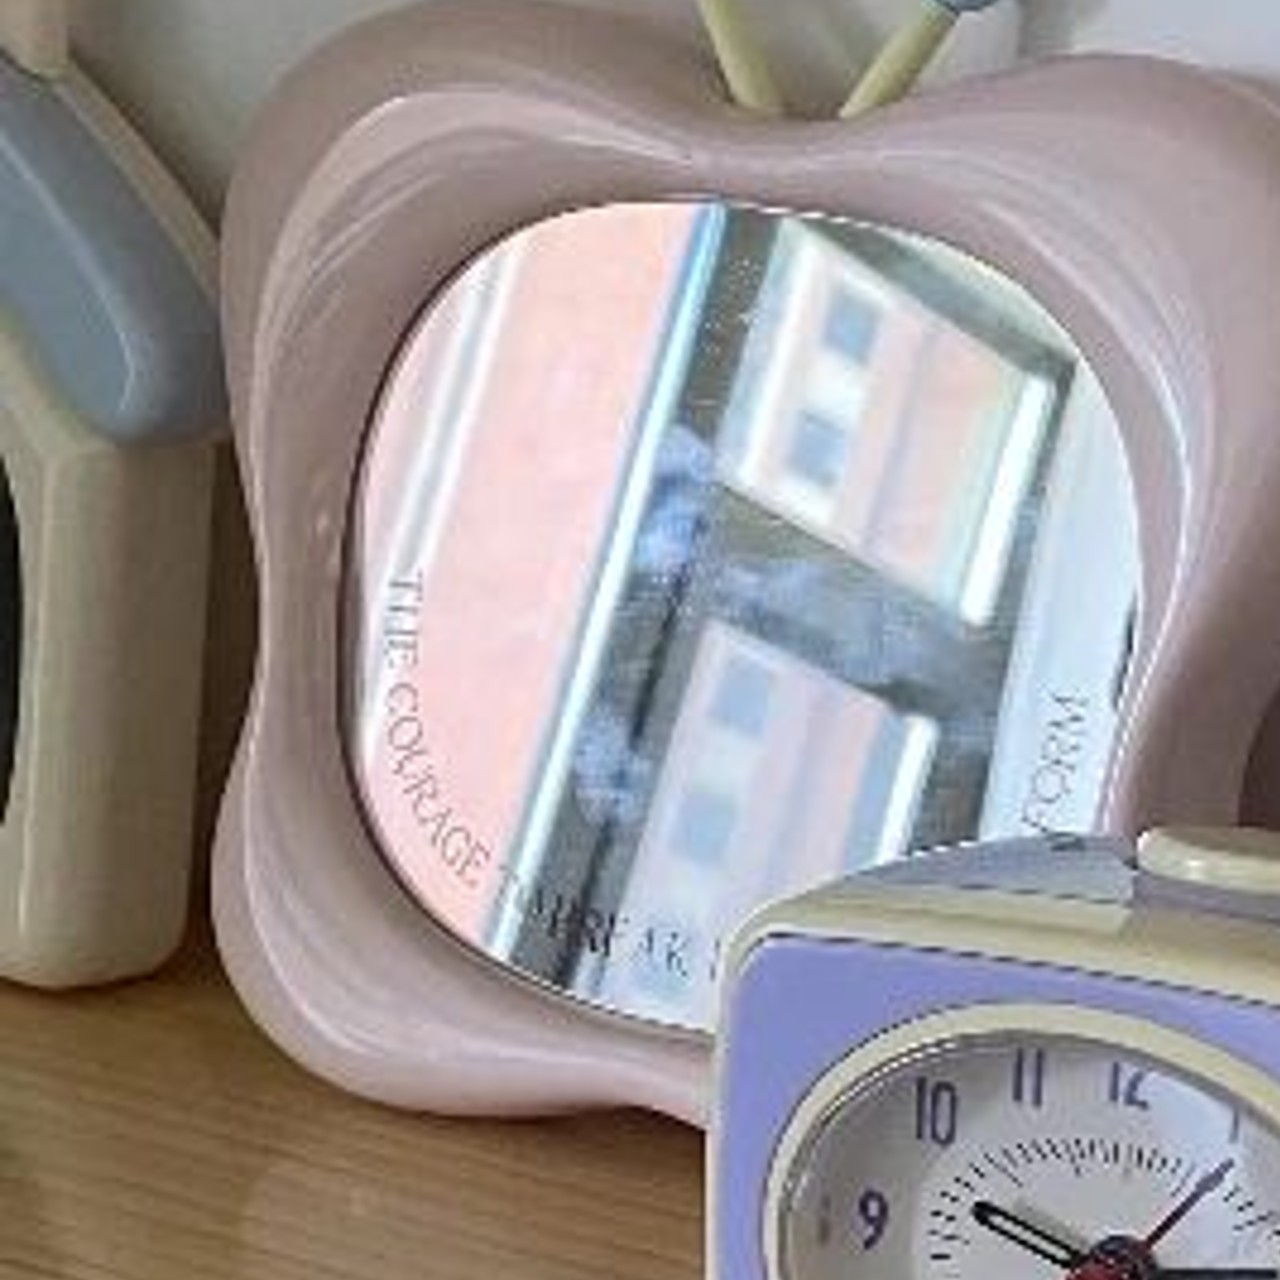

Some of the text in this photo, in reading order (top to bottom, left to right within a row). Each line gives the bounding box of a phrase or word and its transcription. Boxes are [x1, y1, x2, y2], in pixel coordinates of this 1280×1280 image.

[383, 568, 425, 669] THE
[386, 682, 491, 889] COURAGE
[915, 1076, 957, 1146] 10
[1012, 1048, 1046, 1108] 11
[858, 1188, 889, 1251] 9
